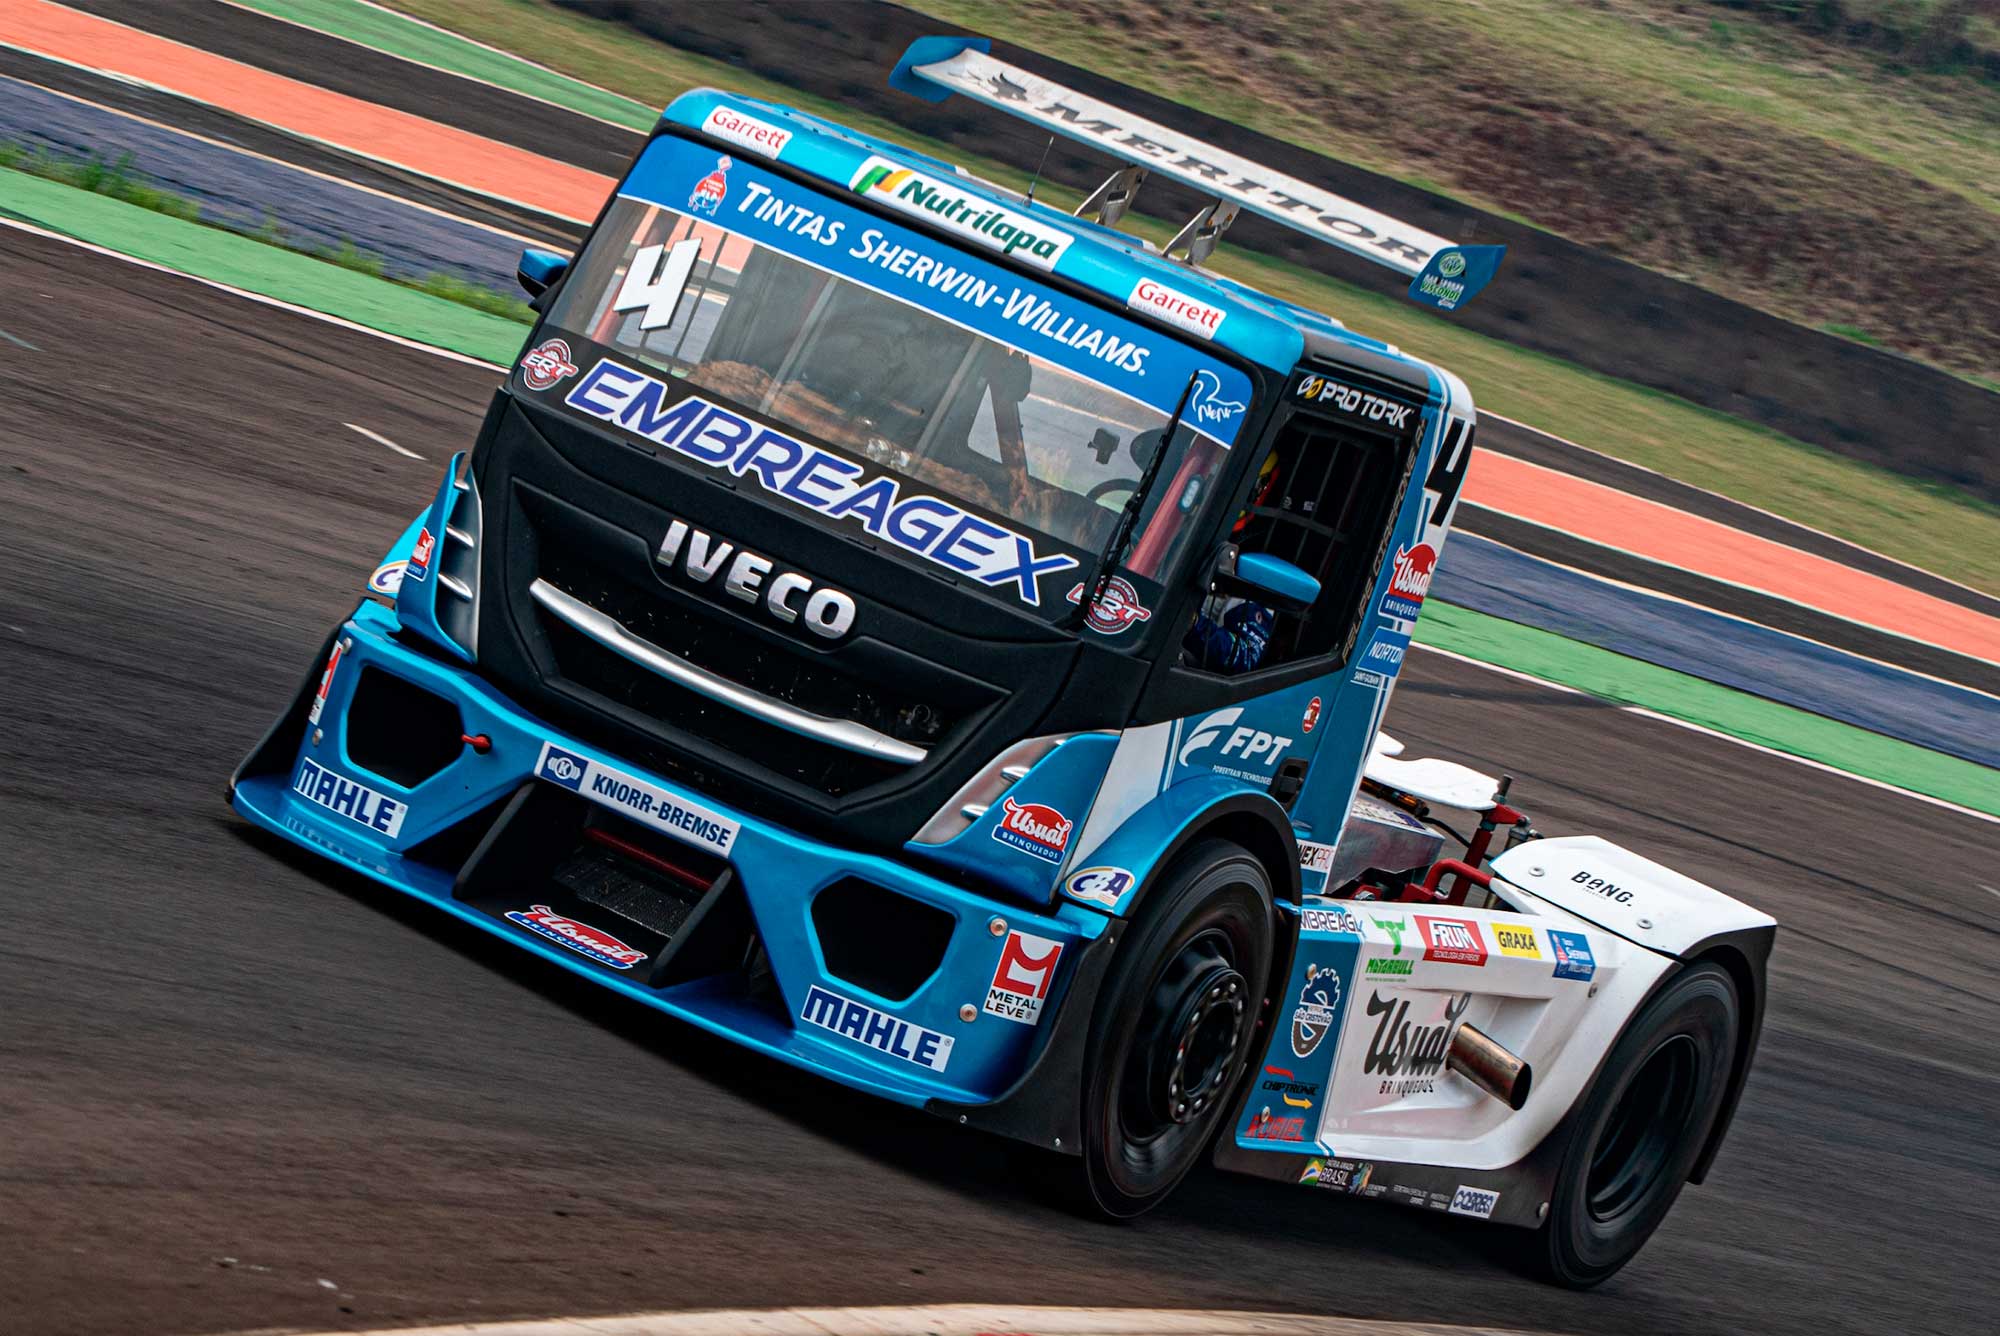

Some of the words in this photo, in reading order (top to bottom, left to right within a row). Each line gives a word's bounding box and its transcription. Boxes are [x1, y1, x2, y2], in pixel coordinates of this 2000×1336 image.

[713, 110, 785, 149] Garrett
[1034, 101, 1432, 266] MERITOR
[737, 181, 846, 246] TINTAS
[900, 180, 1061, 260] Nutrilapa
[613, 237, 702, 331] 4
[1138, 282, 1219, 328] Garrett
[525, 352, 574, 377] ERT
[1318, 381, 1360, 413] PRO
[1360, 396, 1412, 429] TORK
[566, 359, 1077, 604] EMBREAGEX
[1423, 416, 1476, 527] 4
[655, 519, 857, 640] IVECO
[1219, 726, 1293, 766] FPT
[297, 757, 397, 833] MAHLE
[591, 772, 732, 848] KNORR-BREMSE
[1001, 831, 1059, 860] BRINQUEDOS
[1005, 799, 1070, 847] Usual
[1072, 872, 1130, 898] CBA
[520, 917, 616, 963] BRINQUEDOS
[538, 905, 643, 960] Usual
[1428, 919, 1481, 952] FRUM
[1498, 930, 1538, 951] GRAXA
[984, 1002, 1025, 1020] LEVE
[988, 989, 1038, 1011] METAL
[802, 986, 942, 1068] MAHLE
[1363, 987, 1473, 1077] Usual
[1378, 1079, 1434, 1098] BRINQUEDOS
[1319, 1167, 1350, 1186] BRASIL
